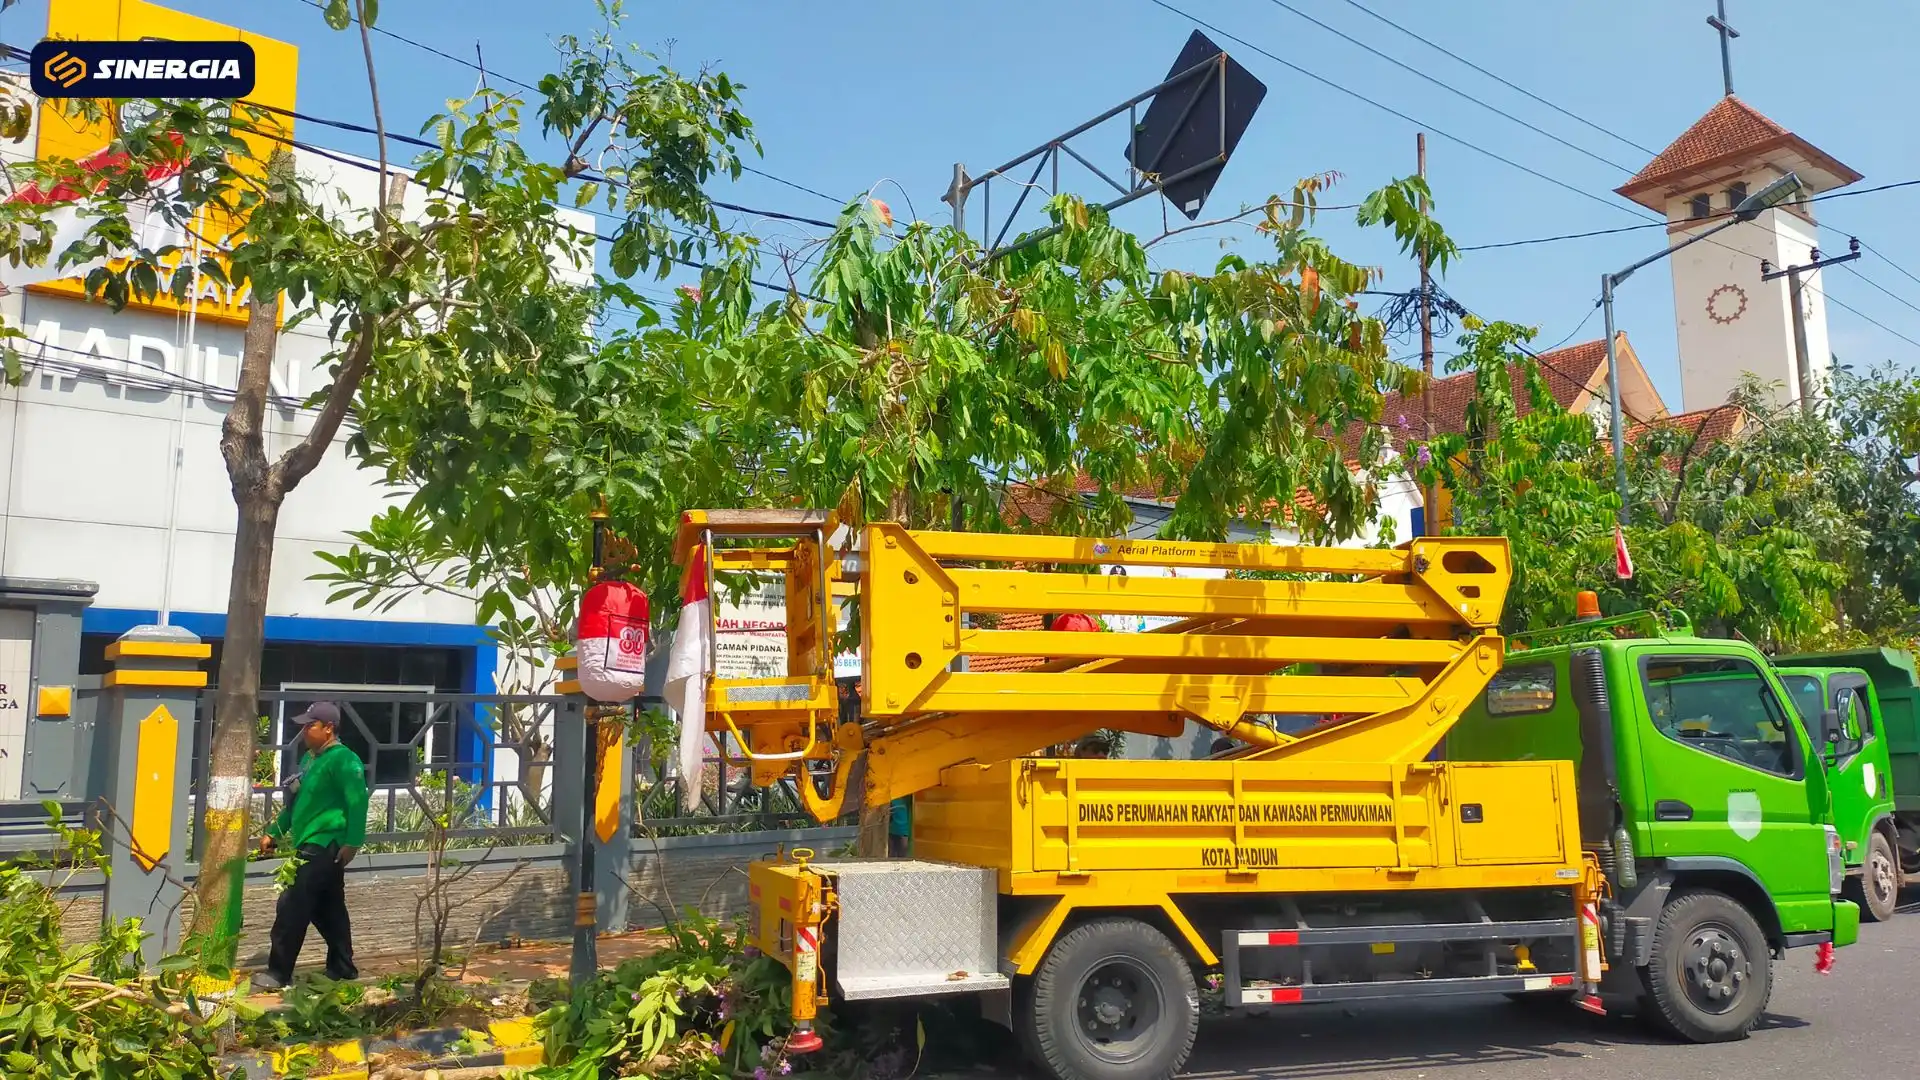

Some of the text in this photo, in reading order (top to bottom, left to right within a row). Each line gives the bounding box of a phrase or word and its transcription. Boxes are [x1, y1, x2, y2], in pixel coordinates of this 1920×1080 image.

[1, 315, 301, 403] MADIUN
[1117, 545, 1149, 555] Aerial
[1151, 546, 1196, 557] Platform
[716, 643, 748, 651] CAMAN
[750, 645, 782, 653] PIDANA
[1079, 804, 1392, 823] DINAS PERUMAHAN RAKYAT DAN KAWASAN PERMUKIMAN
[1202, 848, 1278, 867] KOTA MADIUN
